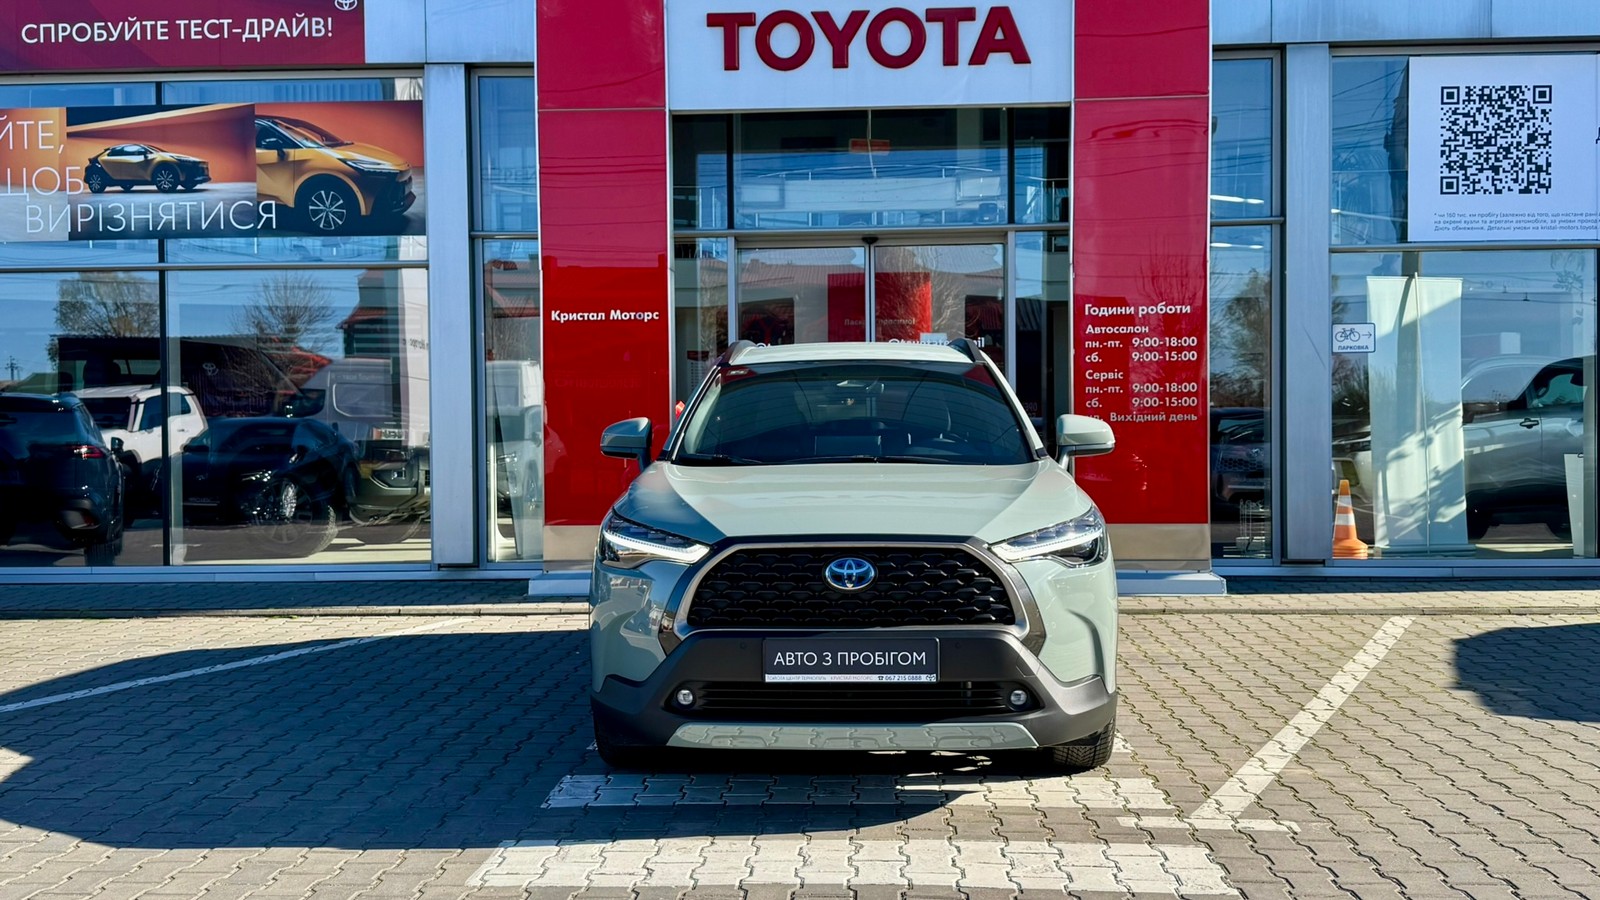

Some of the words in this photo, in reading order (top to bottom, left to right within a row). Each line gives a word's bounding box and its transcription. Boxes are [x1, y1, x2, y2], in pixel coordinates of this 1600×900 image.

[21, 17, 169, 44] СПРОБУЙТЕ
[177, 13, 334, 42] ТЕСТ-ДРАЙВ!
[706, 6, 1032, 71] TOYOTA
[26, 199, 277, 234] ВИРІЗНЯТИСЯ
[551, 309, 606, 323] Кристал
[609, 308, 660, 323] Моторс
[1084, 303, 1135, 317] Години
[1138, 301, 1191, 317] роботи
[1085, 324, 1149, 334] Автосалон
[1085, 340, 1123, 348] пн.-пт.
[1131, 336, 1198, 347] 9:00-18:00
[1085, 351, 1102, 362] сб.
[1131, 351, 1198, 362] 9:00-15:00
[1085, 369, 1124, 382] Сервіс
[1131, 382, 1198, 393] 9:00-18:00
[1085, 397, 1102, 408] сб.
[1131, 397, 1198, 407] 9:00-15:00
[1110, 411, 1166, 422] Вихідний
[1169, 413, 1198, 422] день
[773, 652, 817, 666] АВТО
[837, 651, 926, 666] ПРОБІГОМ
